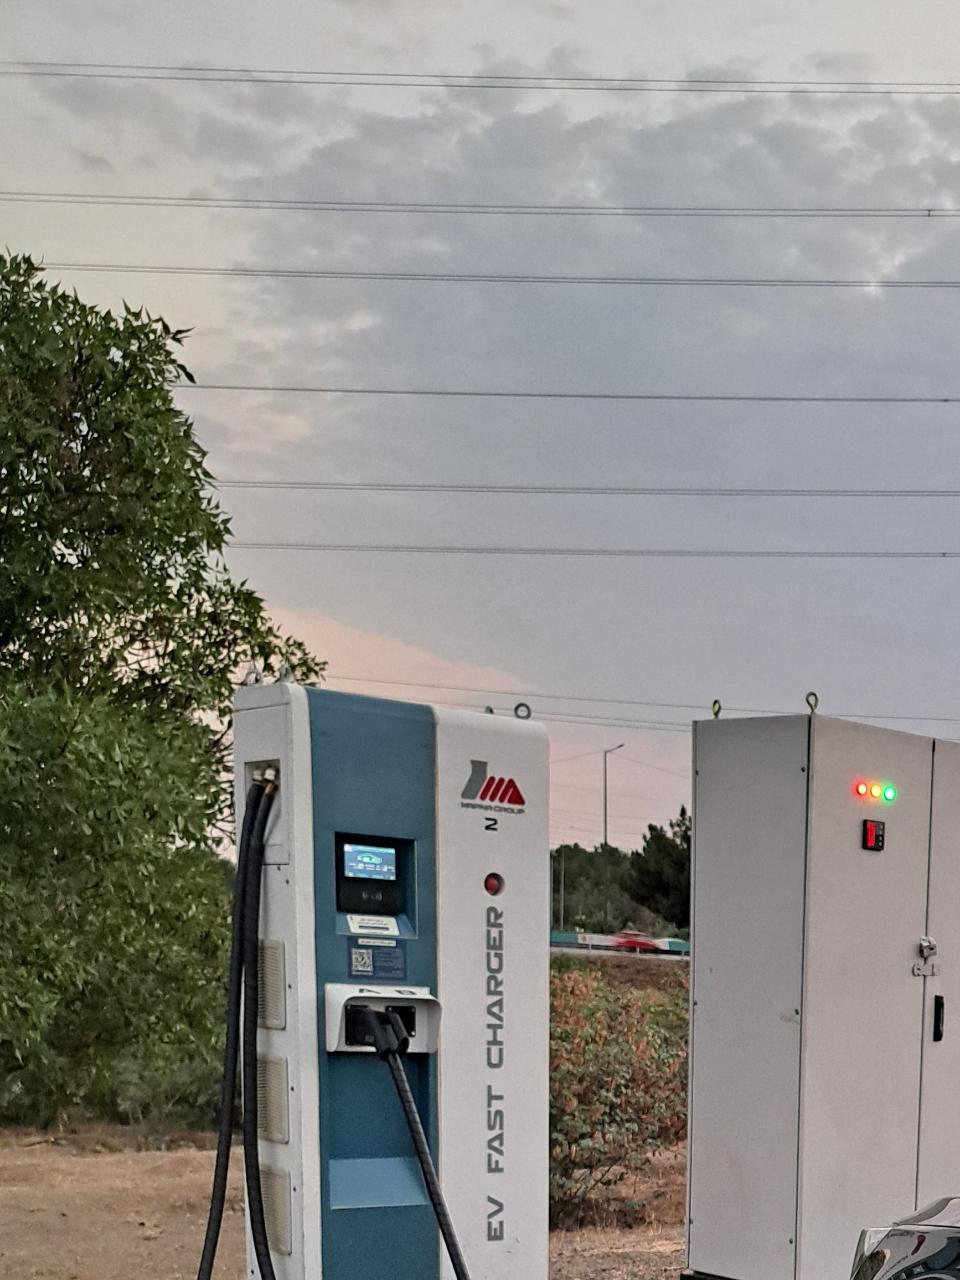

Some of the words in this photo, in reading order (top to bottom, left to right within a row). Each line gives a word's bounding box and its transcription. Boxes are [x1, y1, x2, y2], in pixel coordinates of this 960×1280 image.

[484, 817, 498, 831] 2
[486, 905, 504, 1069] CHARGER
[487, 1085, 504, 1174] FAST
[487, 1195, 504, 1242] EV
